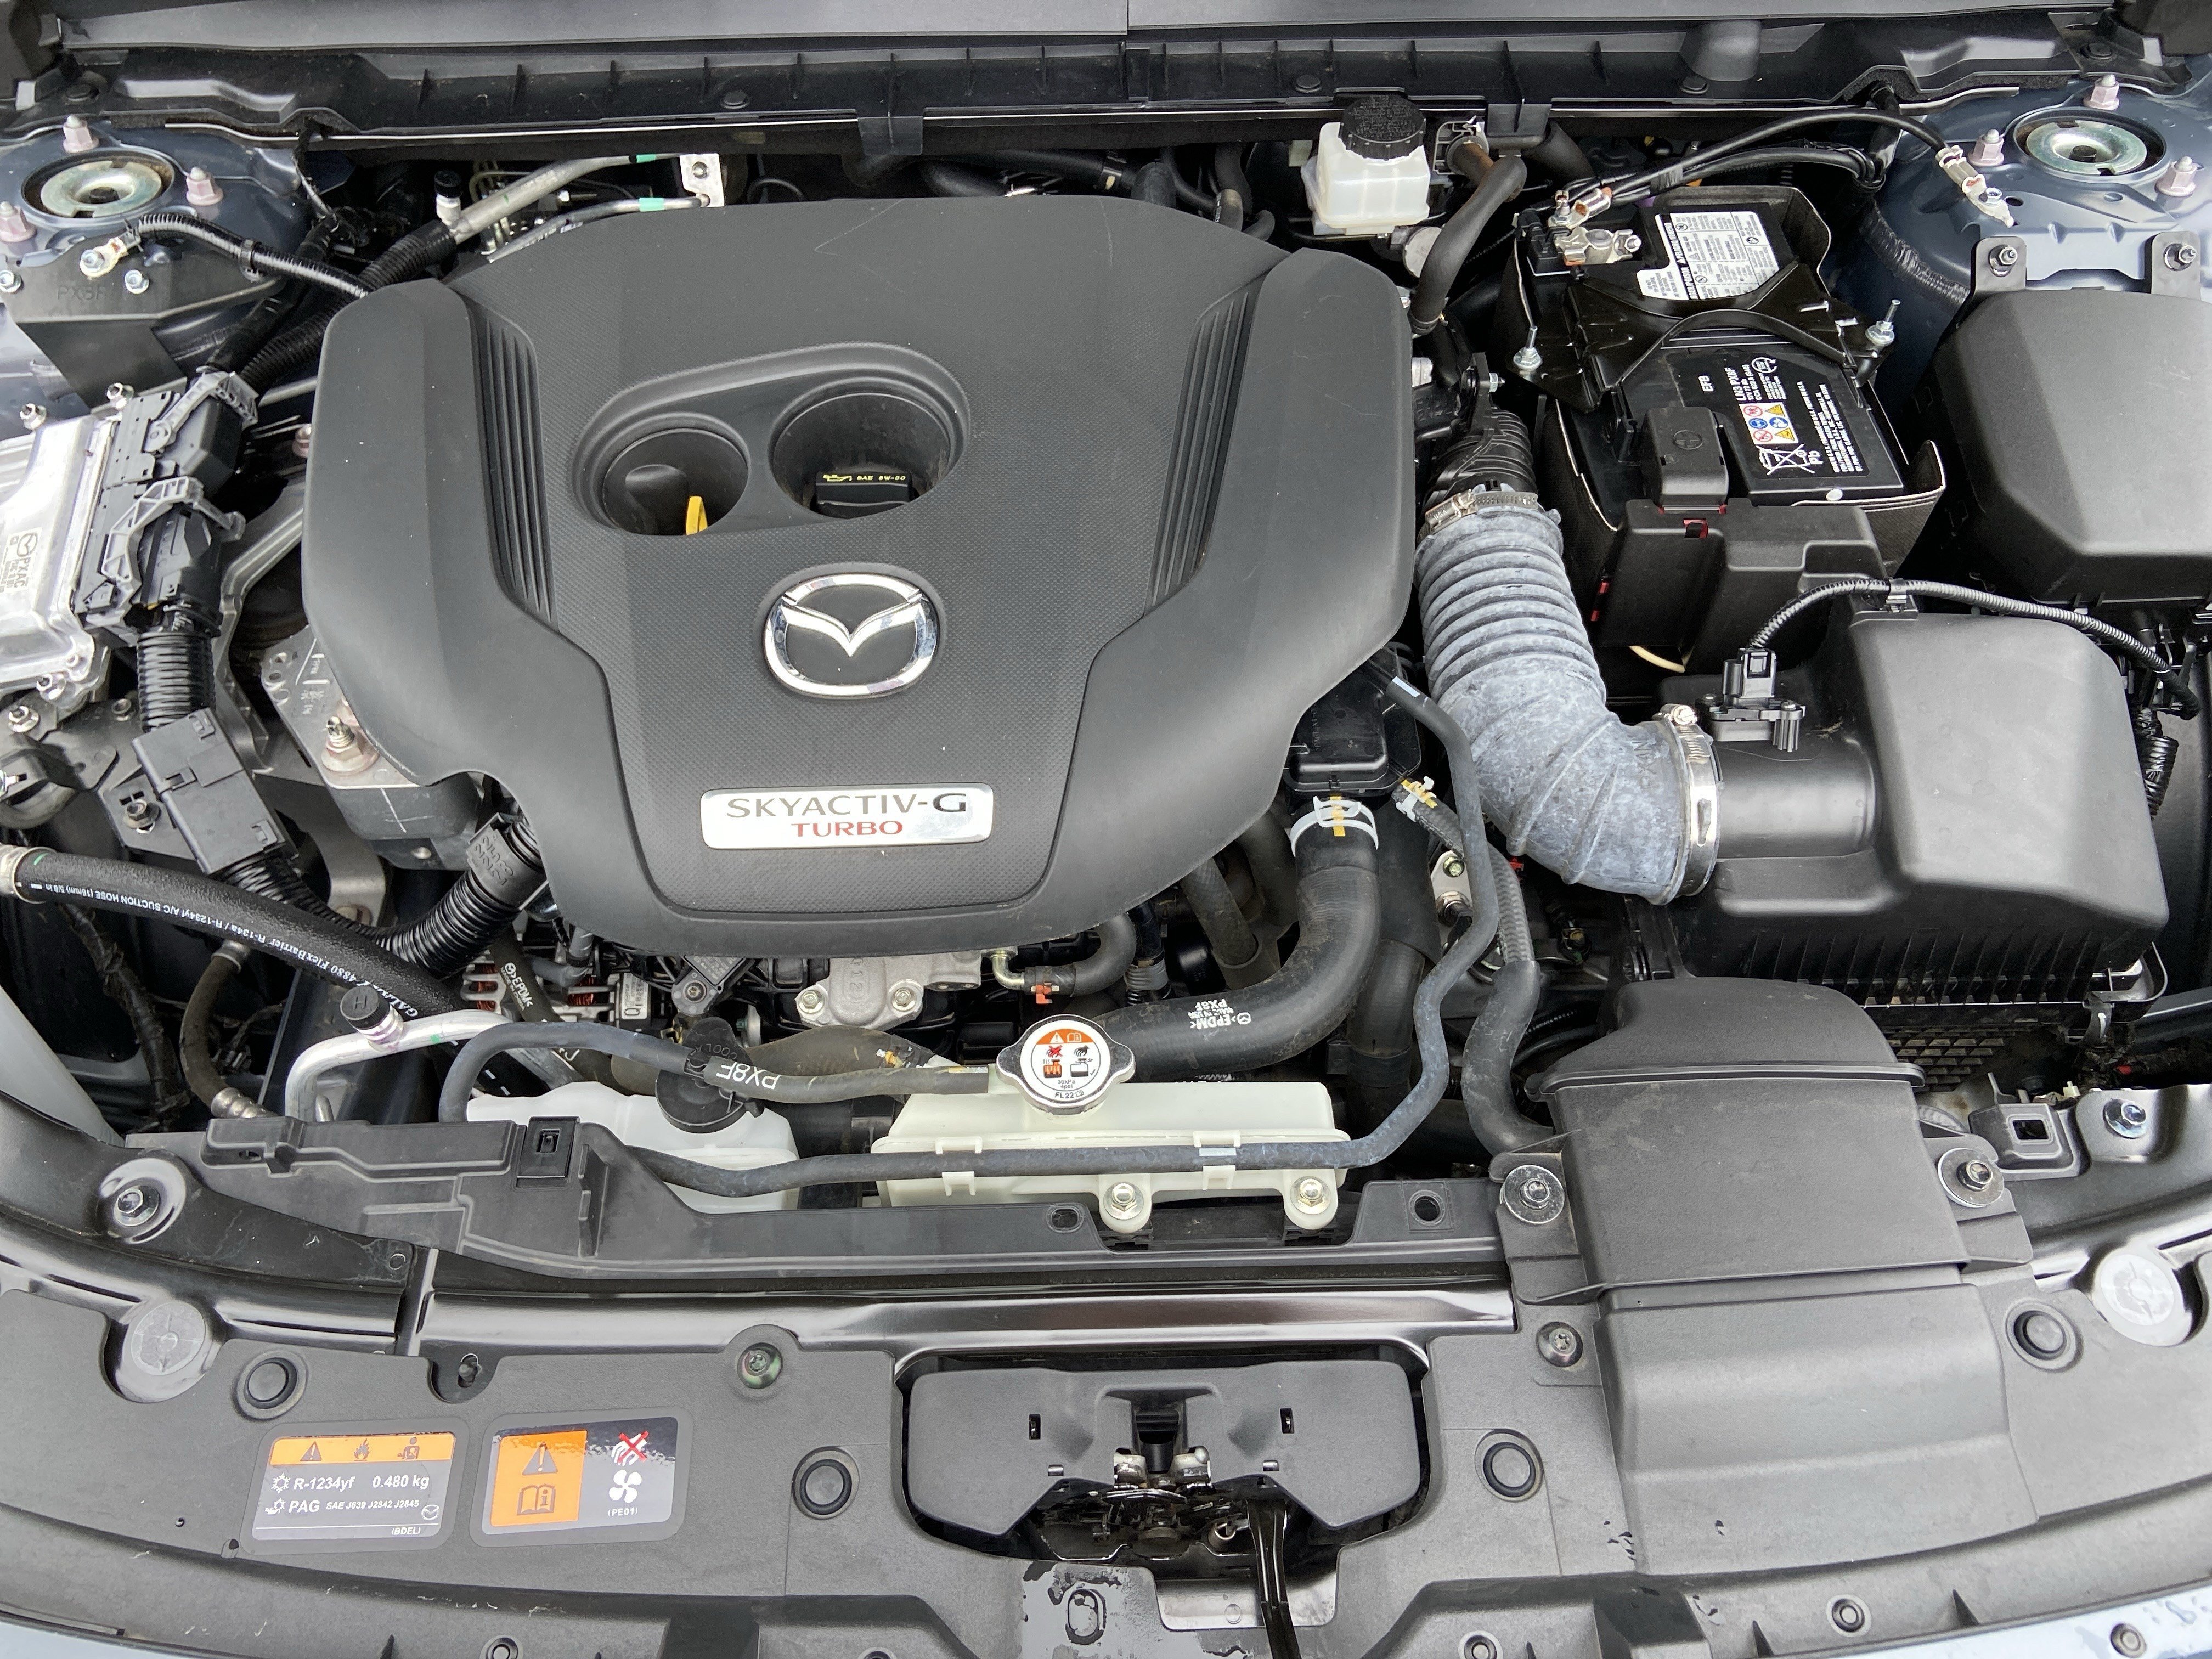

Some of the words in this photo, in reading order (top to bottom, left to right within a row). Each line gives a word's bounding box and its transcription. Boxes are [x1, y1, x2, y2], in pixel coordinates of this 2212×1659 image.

[1698, 375, 1713, 392] EFB
[1733, 386, 1747, 401] LN3
[1808, 450, 1823, 464] Pb
[727, 793, 967, 818] SKYACTIV-G
[791, 821, 903, 837] TURBO
[66, 885, 93, 898] (16mm)
[95, 890, 119, 902] HOSE
[121, 895, 161, 911] SUCTION
[163, 904, 180, 916] A/C
[232, 924, 266, 943] R-134a
[269, 938, 330, 970] FlexBarrier
[331, 965, 357, 982] 4880
[353, 995, 368, 1010] H
[1195, 998, 1228, 1011] PX8F
[1190, 1014, 1236, 1029] >EPDM<
[716, 1062, 782, 1090] PX8F
[293, 1476, 356, 1492] R-1234yf
[372, 1475, 409, 1488] 0.480
[412, 1475, 430, 1489] kg
[289, 1500, 320, 1513] PAG
[326, 1502, 345, 1510] SAE
[346, 1501, 366, 1509] J639
[368, 1500, 393, 1509] J2842
[394, 1500, 419, 1508] J2845
[608, 1507, 638, 1517] (PE01)
[392, 1527, 421, 1536] (BDEL)
